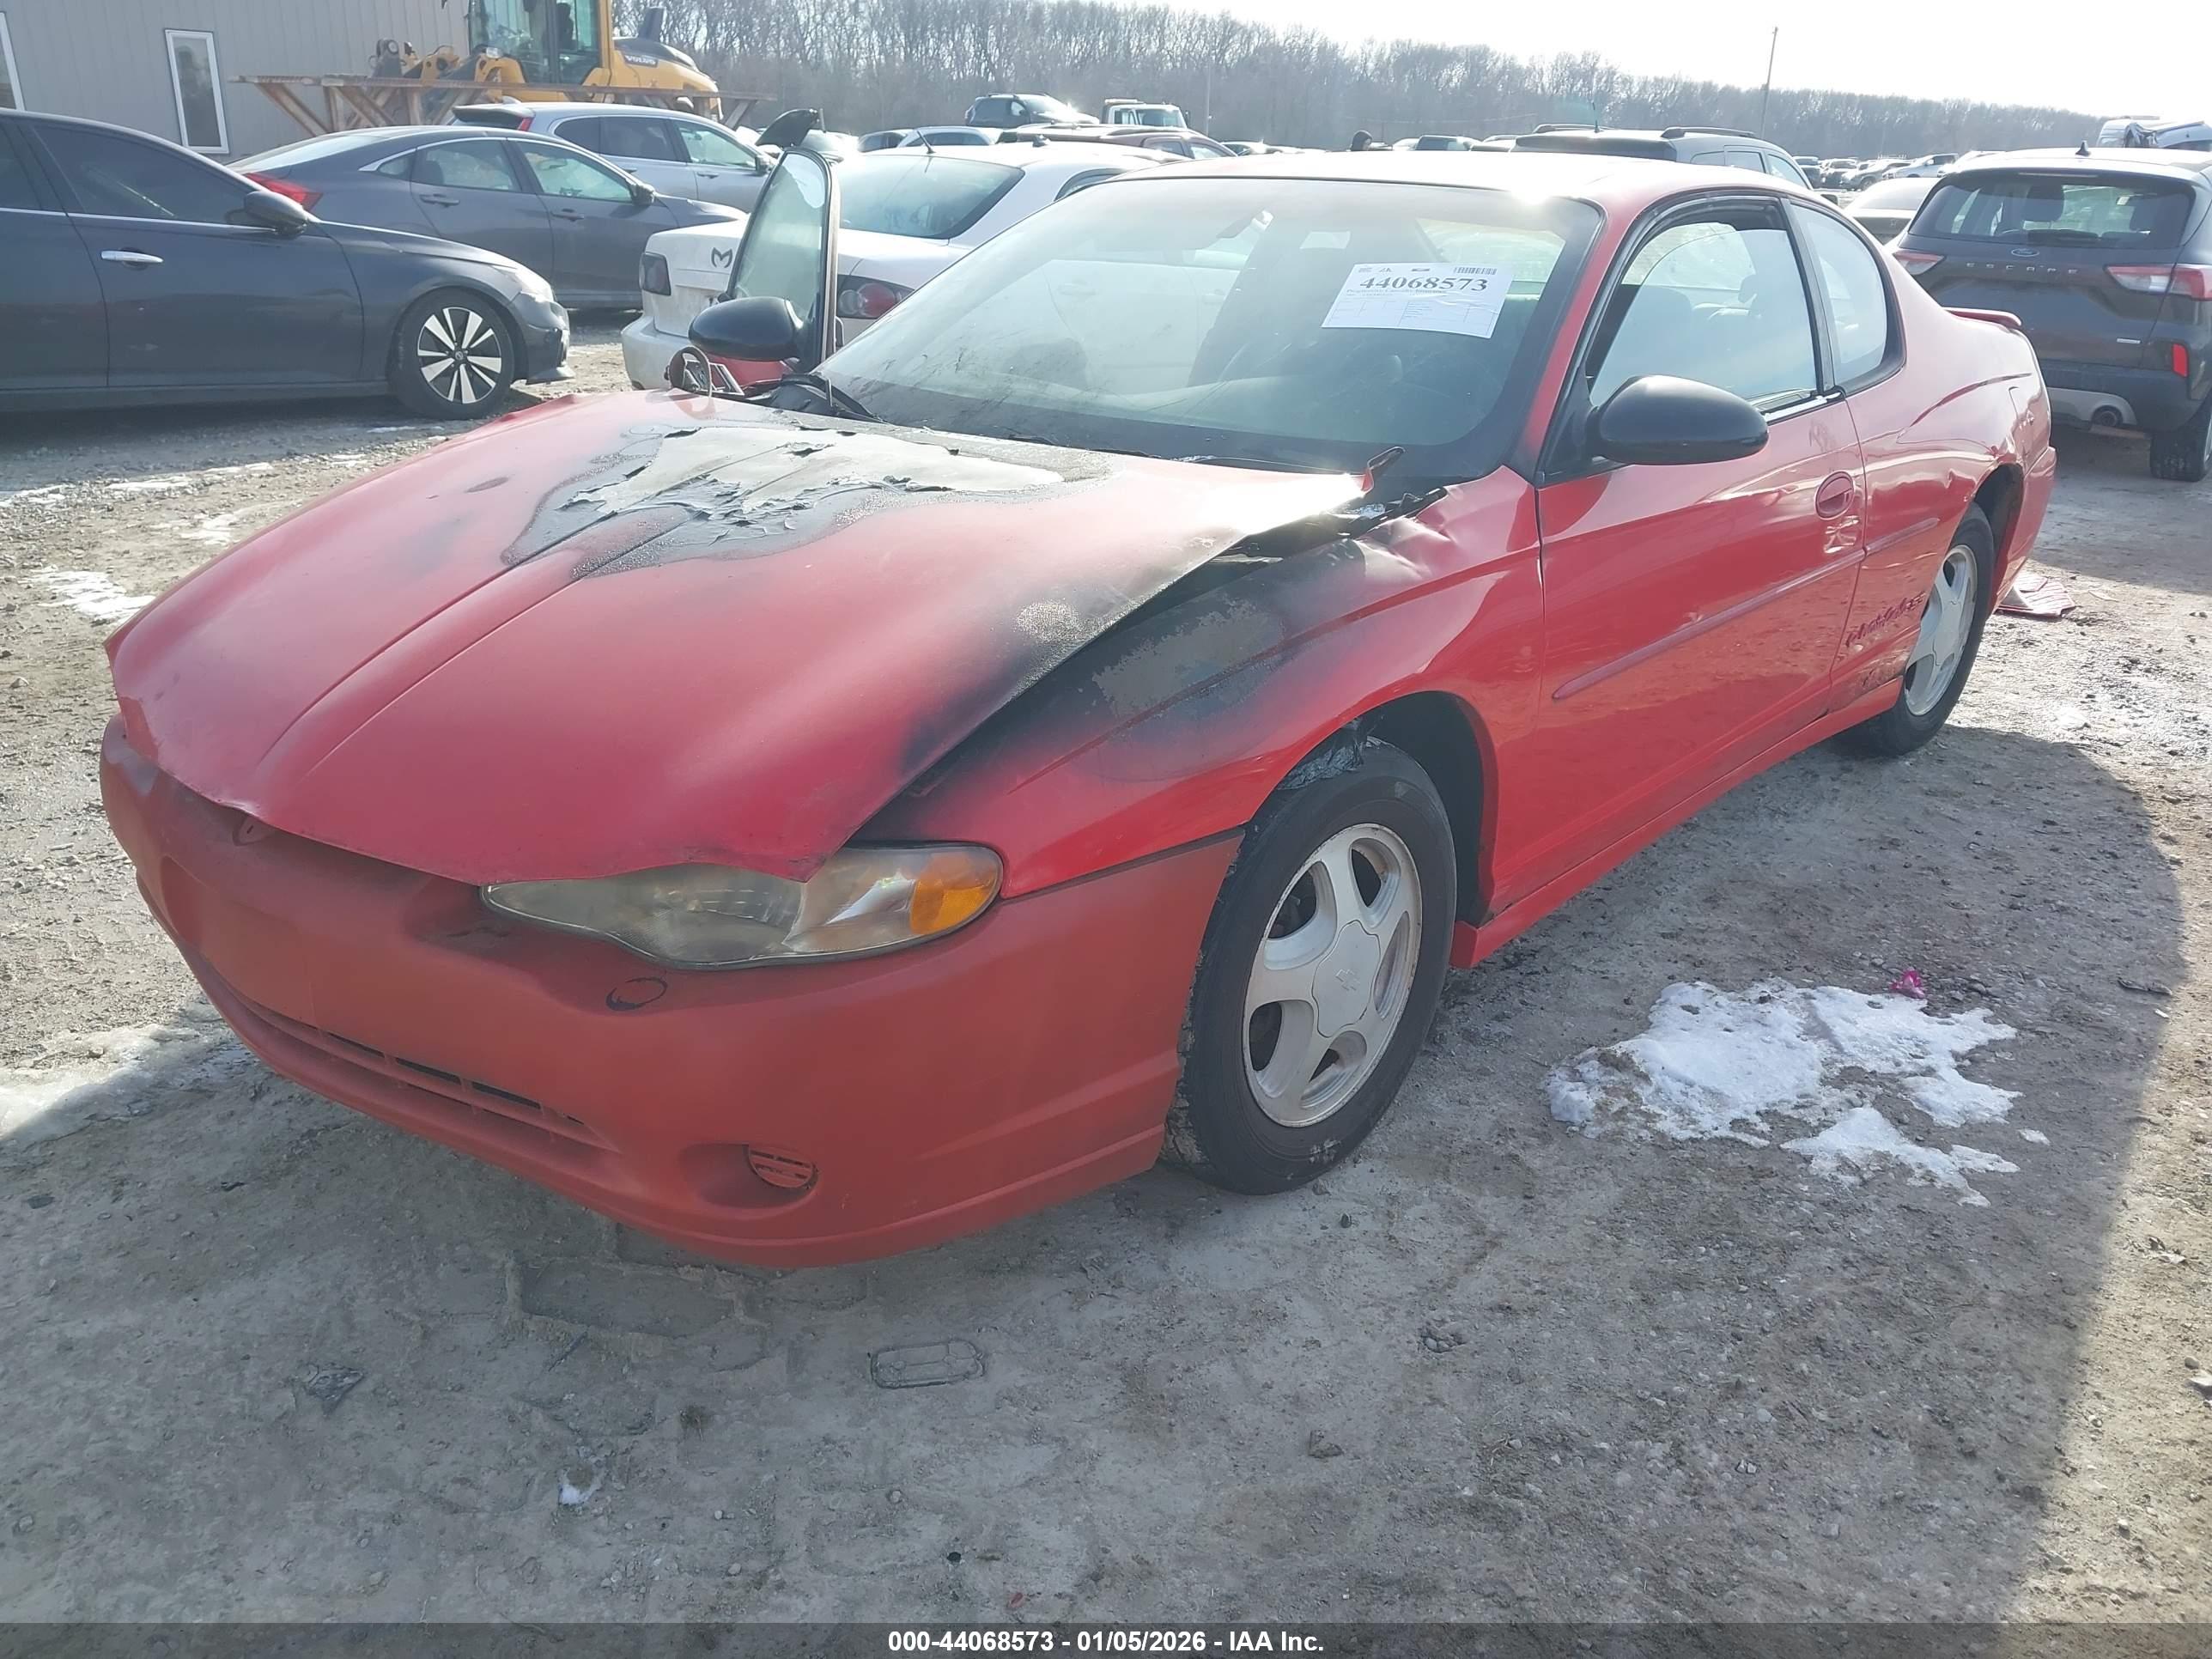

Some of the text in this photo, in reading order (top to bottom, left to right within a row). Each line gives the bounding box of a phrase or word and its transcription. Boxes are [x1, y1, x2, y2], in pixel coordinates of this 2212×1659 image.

[624, 55, 656, 64] VOLVO
[1966, 262, 2078, 274] ESCAPE
[1359, 276, 1488, 291] 44068573
